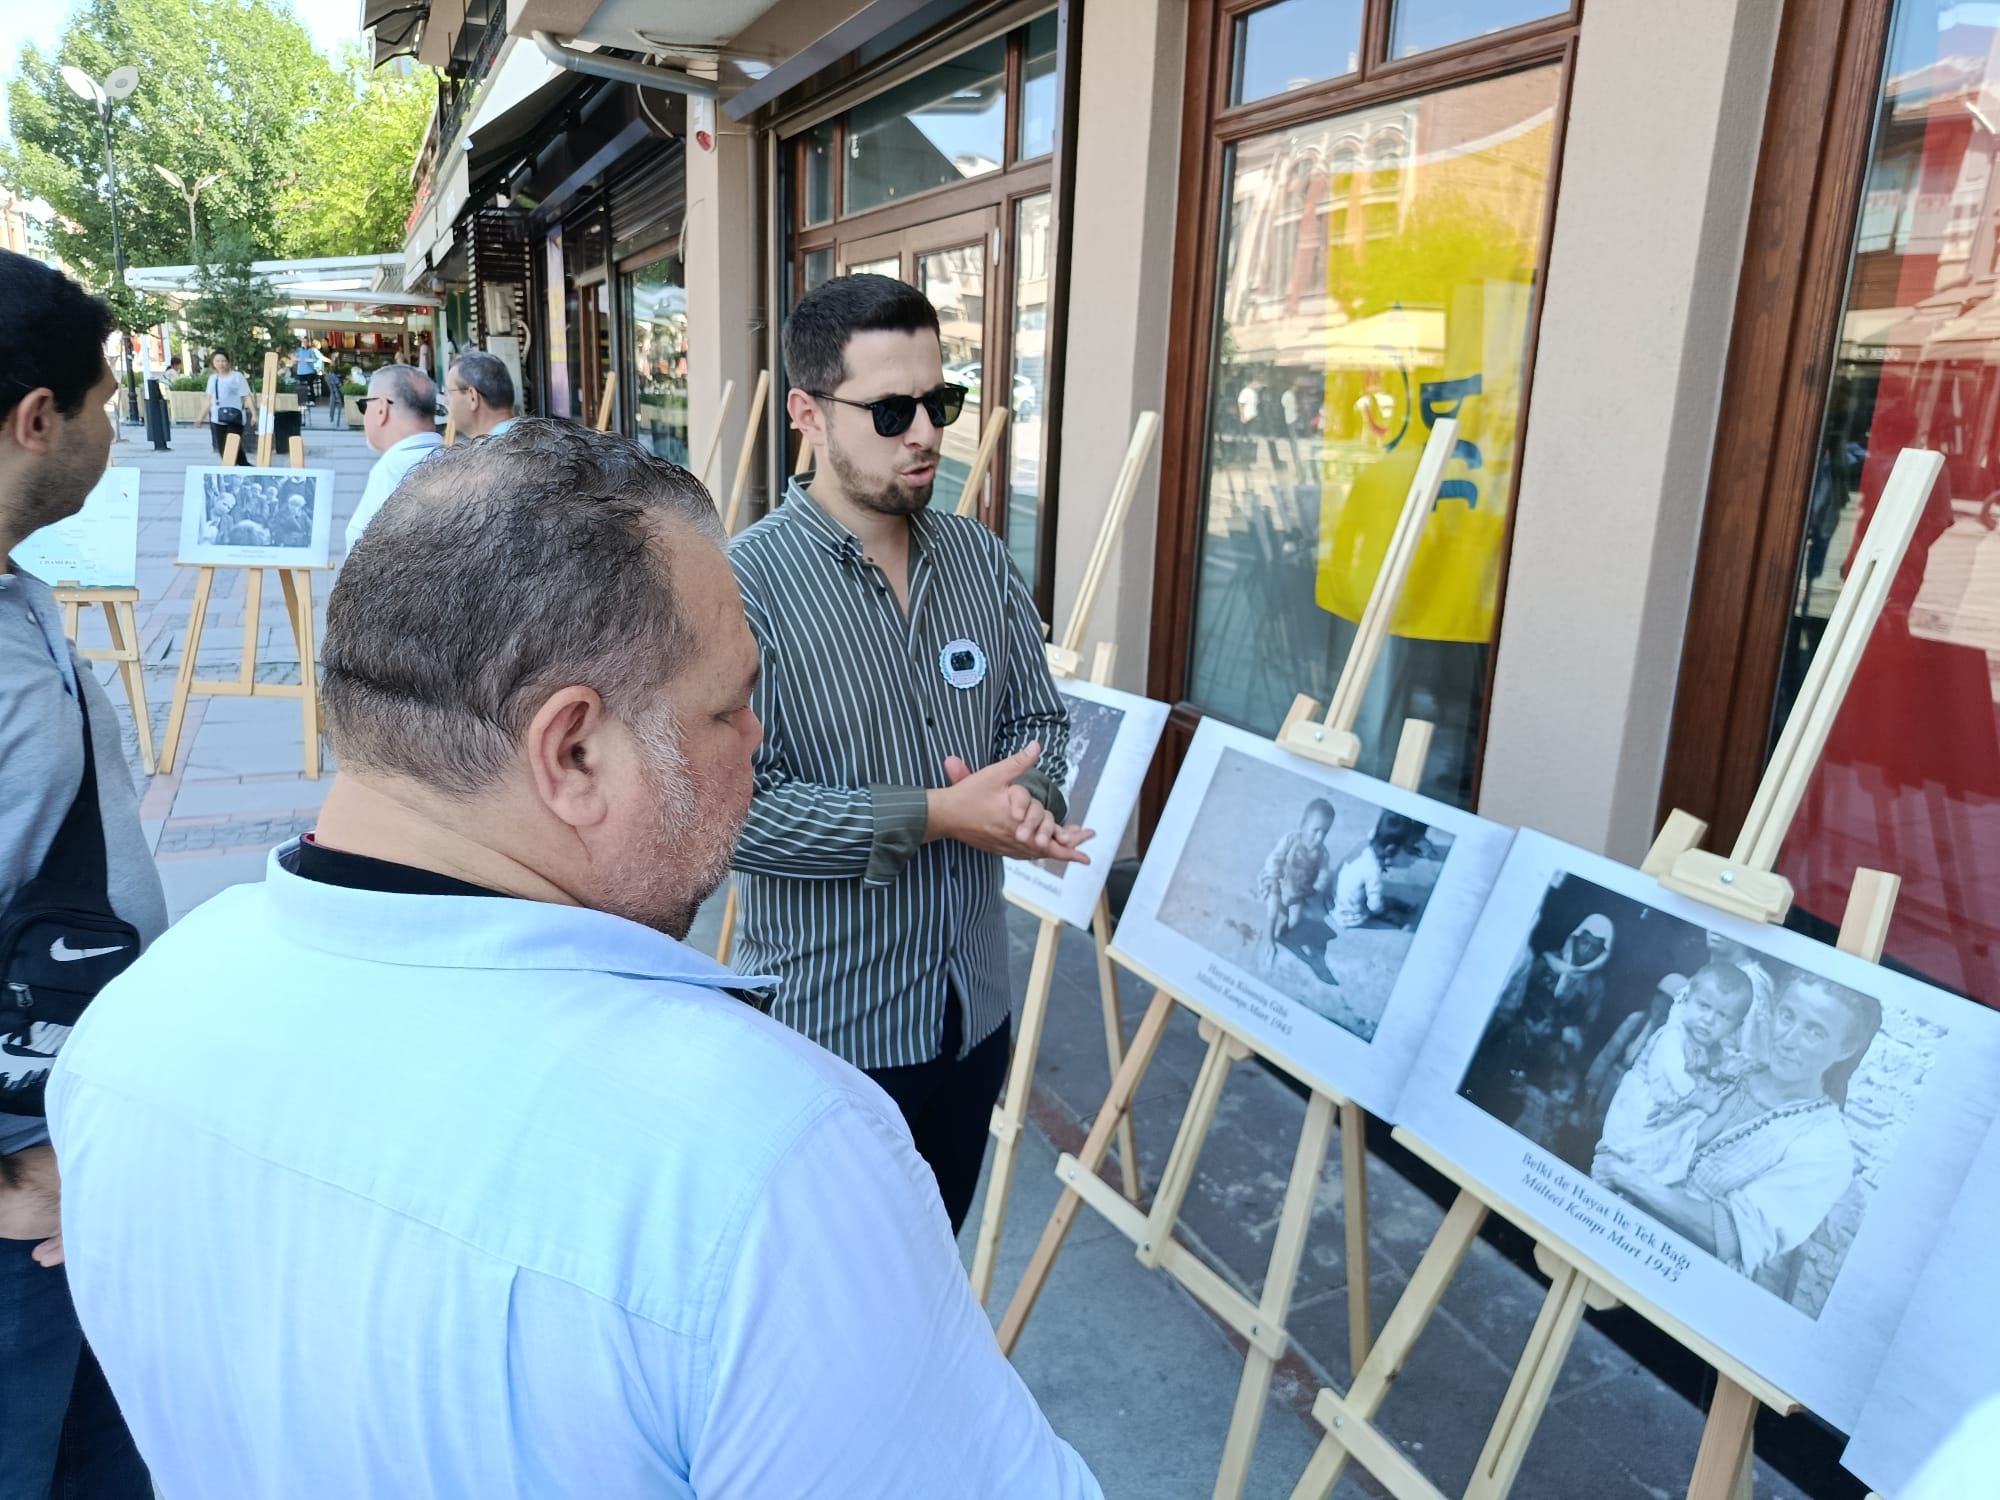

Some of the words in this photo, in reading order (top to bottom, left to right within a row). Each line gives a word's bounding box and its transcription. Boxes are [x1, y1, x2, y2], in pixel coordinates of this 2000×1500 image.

[1270, 1017, 1293, 1036] 1945
[1521, 1151, 1553, 1180] Belki
[1554, 1173, 1570, 1191] de
[1572, 1184, 1609, 1217] Hayat
[1612, 1206, 1630, 1230] İle
[1634, 1221, 1657, 1248] Tek
[1660, 1240, 1691, 1271] Bağı
[1521, 1173, 1564, 1207] Mülteci
[1565, 1201, 1605, 1236] Kampı
[1606, 1230, 1641, 1260] Mart
[1644, 1255, 1681, 1283] 1945
